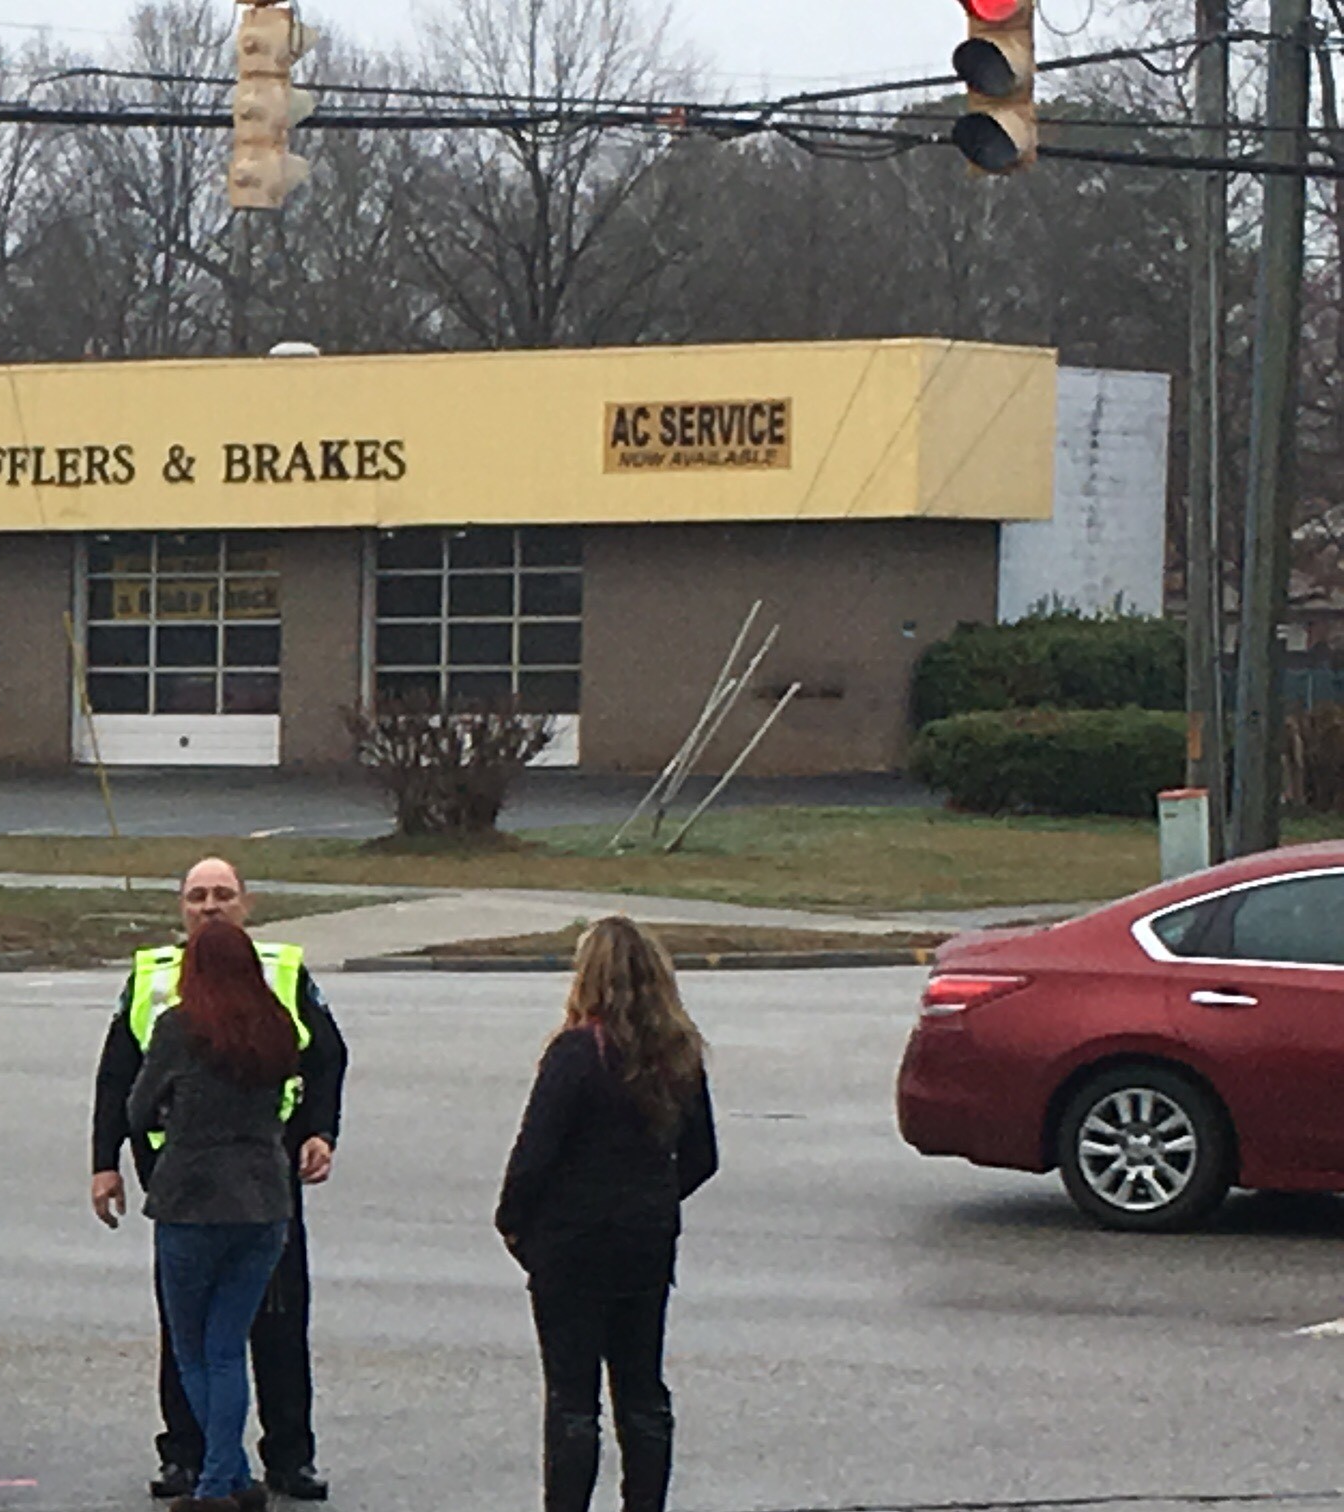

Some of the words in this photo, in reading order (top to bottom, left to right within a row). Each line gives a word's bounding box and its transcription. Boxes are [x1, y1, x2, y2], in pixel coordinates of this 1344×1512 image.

[611, 406, 650, 447] AC
[659, 402, 786, 447] SERVICE
[162, 443, 195, 484] &
[222, 438, 406, 485] BRAKES
[618, 452, 665, 468] NOW
[670, 449, 777, 467] AVAILABLE
